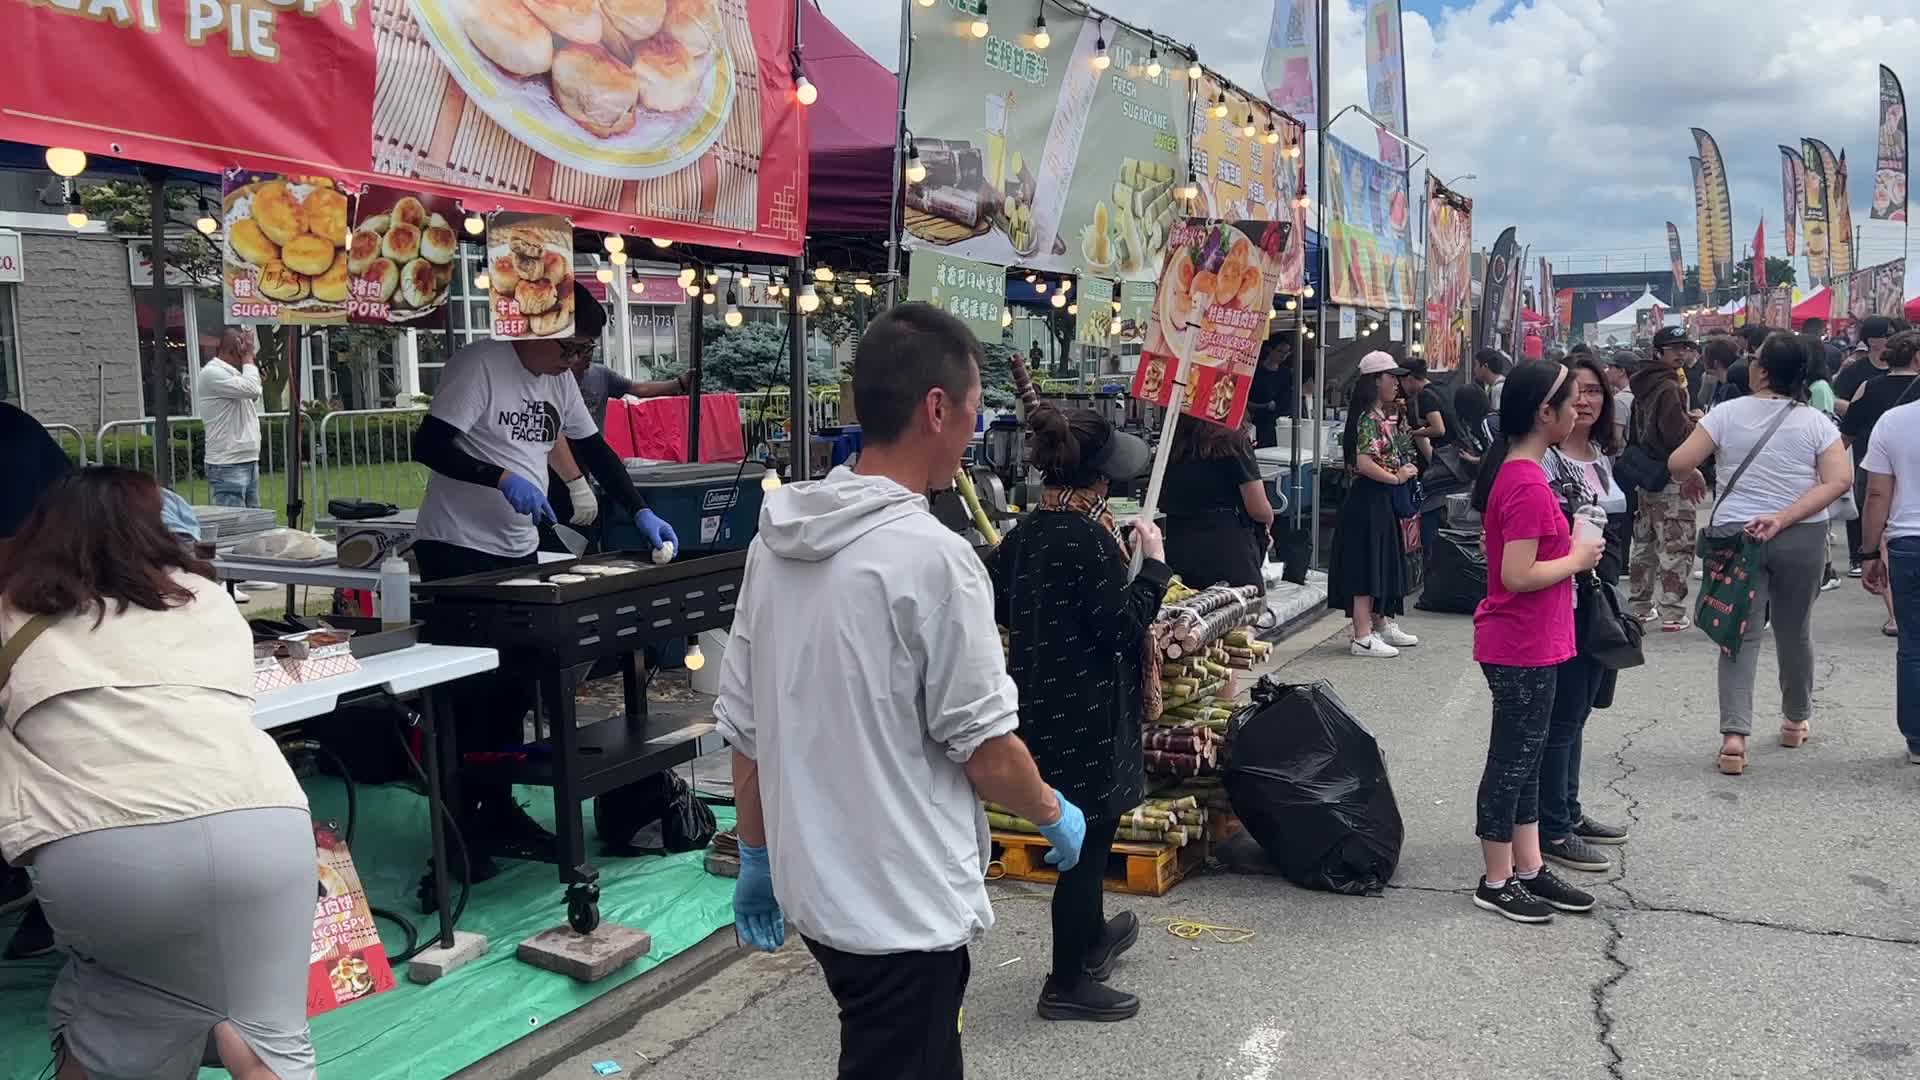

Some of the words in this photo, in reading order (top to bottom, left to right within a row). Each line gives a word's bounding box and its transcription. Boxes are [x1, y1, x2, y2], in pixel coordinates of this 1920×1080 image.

[190, 0, 276, 57] PIE
[1112, 76, 1136, 98] FRESH
[1122, 101, 1167, 130] SUGARCANE
[1154, 134, 1176, 152] JUICE
[233, 278, 250, 297] 糖
[353, 278, 381, 298] 猪肉
[232, 304, 278, 317] SUGAR
[348, 302, 390, 319] PORK
[497, 300, 521, 316] 牛肉
[496, 319, 525, 335] BEEF
[511, 427, 542, 442] FACE
[323, 916, 365, 937] CRISPY
[331, 933, 352, 947] PIE
